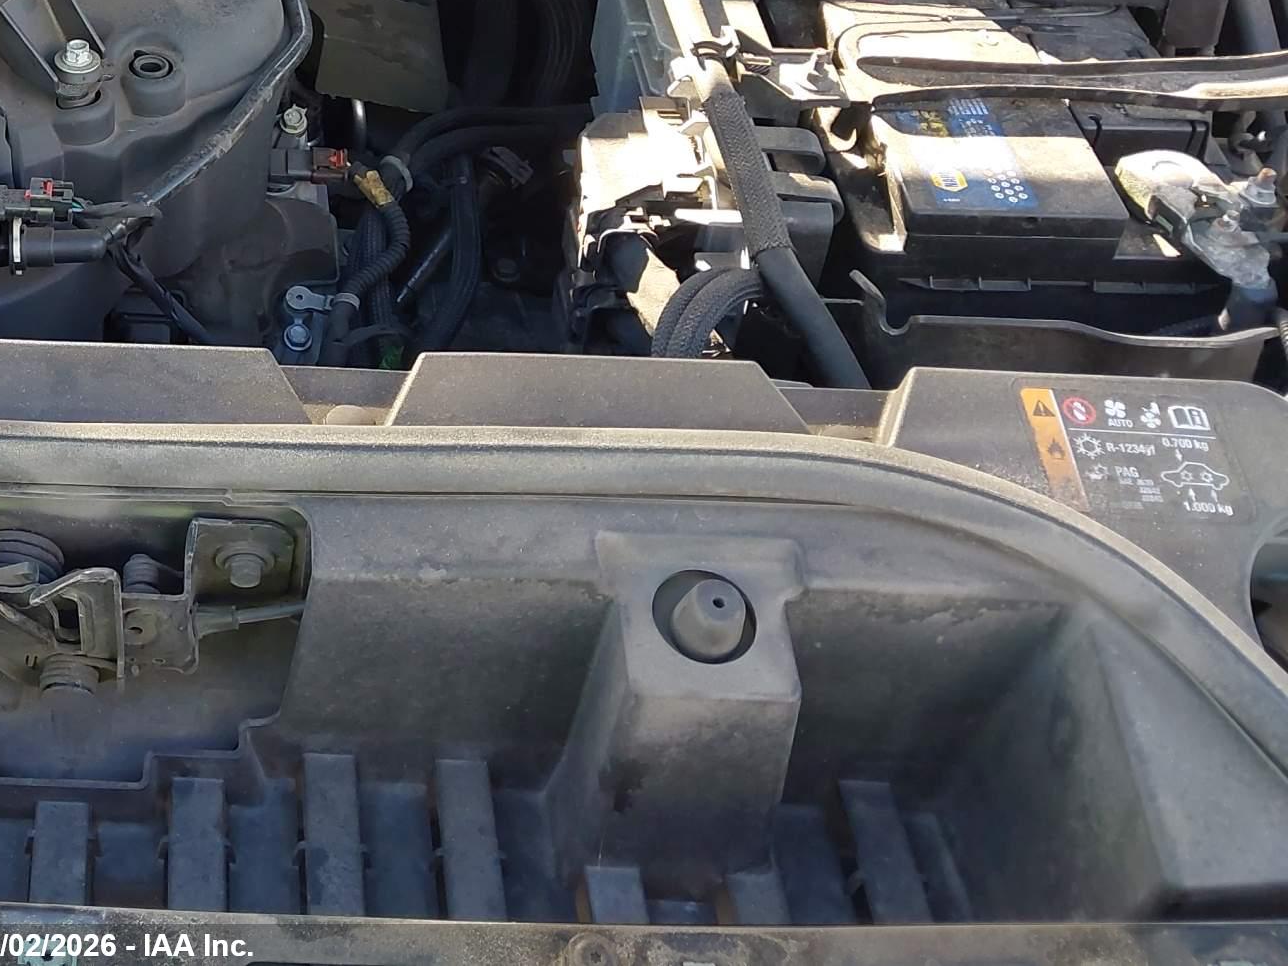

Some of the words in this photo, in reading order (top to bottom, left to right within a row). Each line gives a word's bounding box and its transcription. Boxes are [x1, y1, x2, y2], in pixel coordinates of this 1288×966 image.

[1108, 418, 1133, 428] AUTO
[1194, 439, 1210, 452] kg
[1114, 465, 1140, 478] PAG
[1216, 503, 1234, 516] kg
